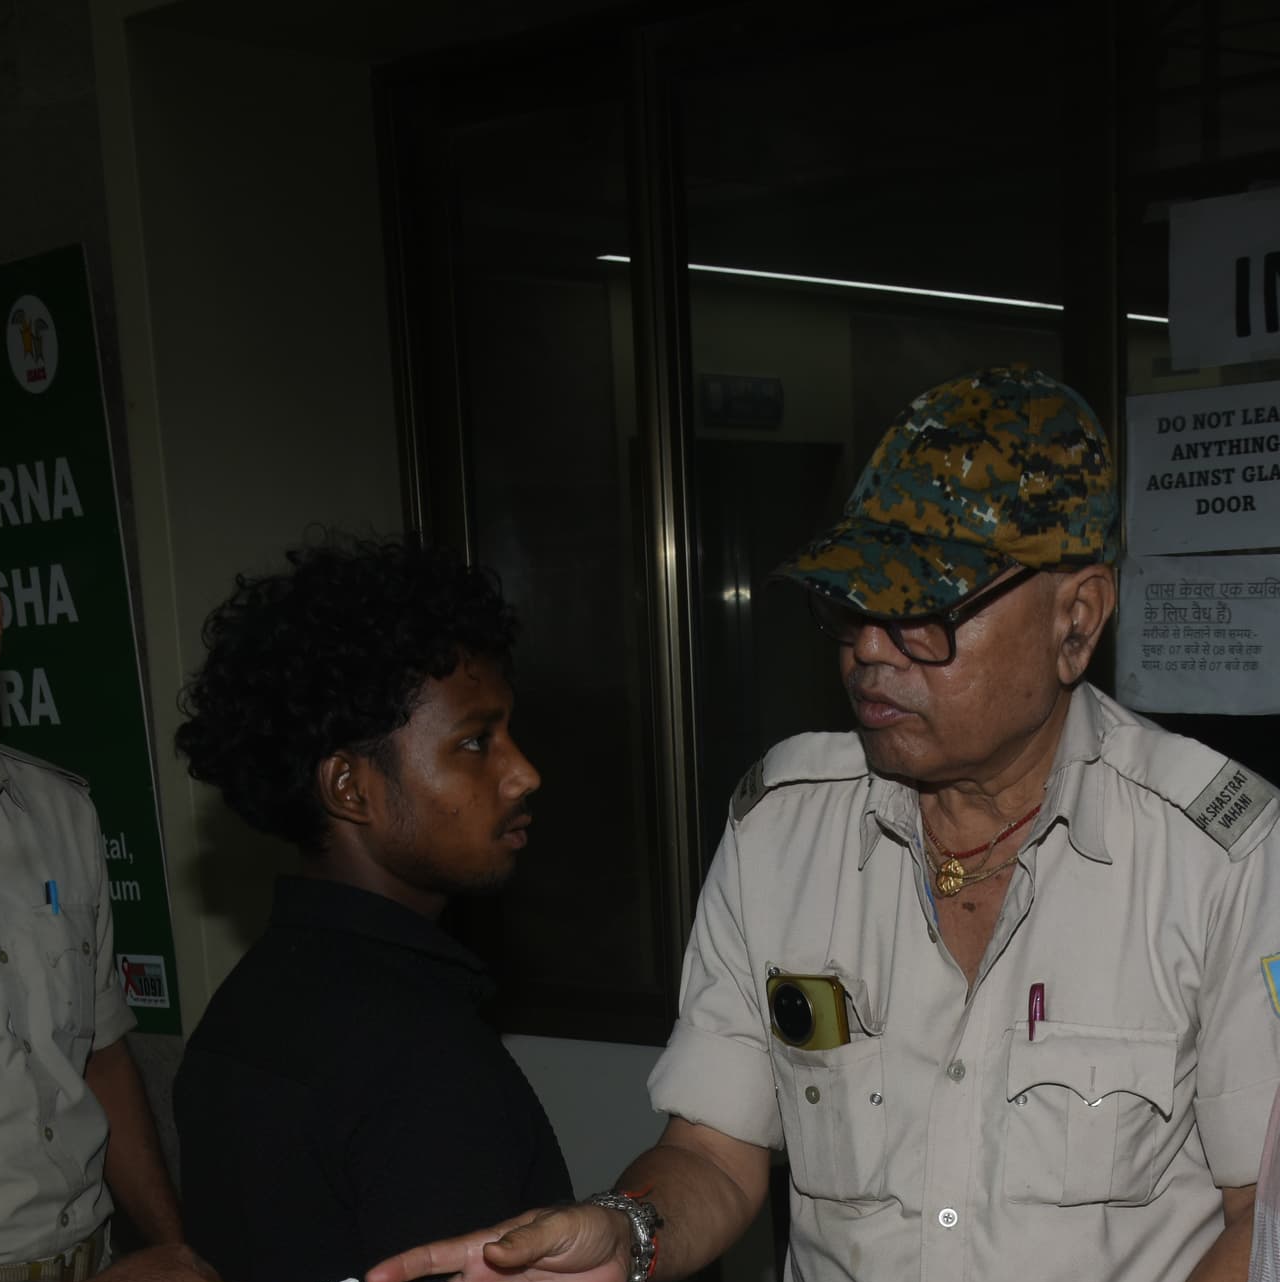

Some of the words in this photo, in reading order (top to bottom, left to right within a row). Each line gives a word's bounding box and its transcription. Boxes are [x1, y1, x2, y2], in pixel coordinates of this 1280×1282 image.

[1156, 415, 1186, 434] DO
[1192, 411, 1235, 431] NOT
[1171, 434, 1280, 461] ANYTHING
[1146, 468, 1235, 491] AGAINST
[1196, 495, 1257, 515] DOOR
[1218, 793, 1253, 829] VAHANI
[138, 976, 162, 997] 1097
